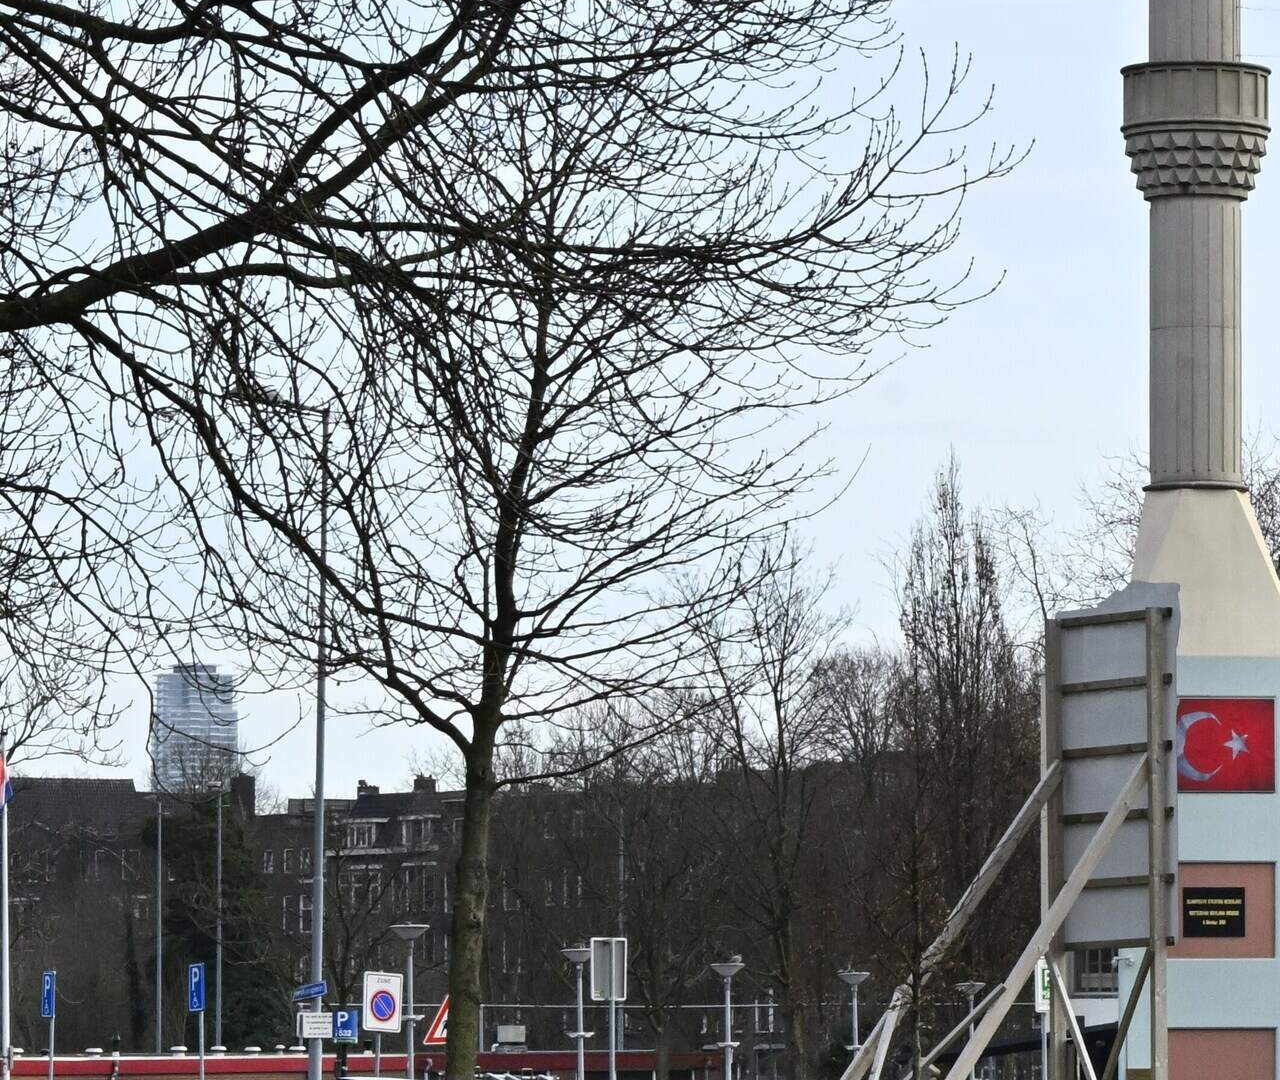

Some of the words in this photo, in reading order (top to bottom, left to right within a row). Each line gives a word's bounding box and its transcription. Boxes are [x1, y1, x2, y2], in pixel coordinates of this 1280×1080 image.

[45, 976, 50, 997] P
[191, 968, 199, 991] P
[337, 1011, 349, 1027] P
